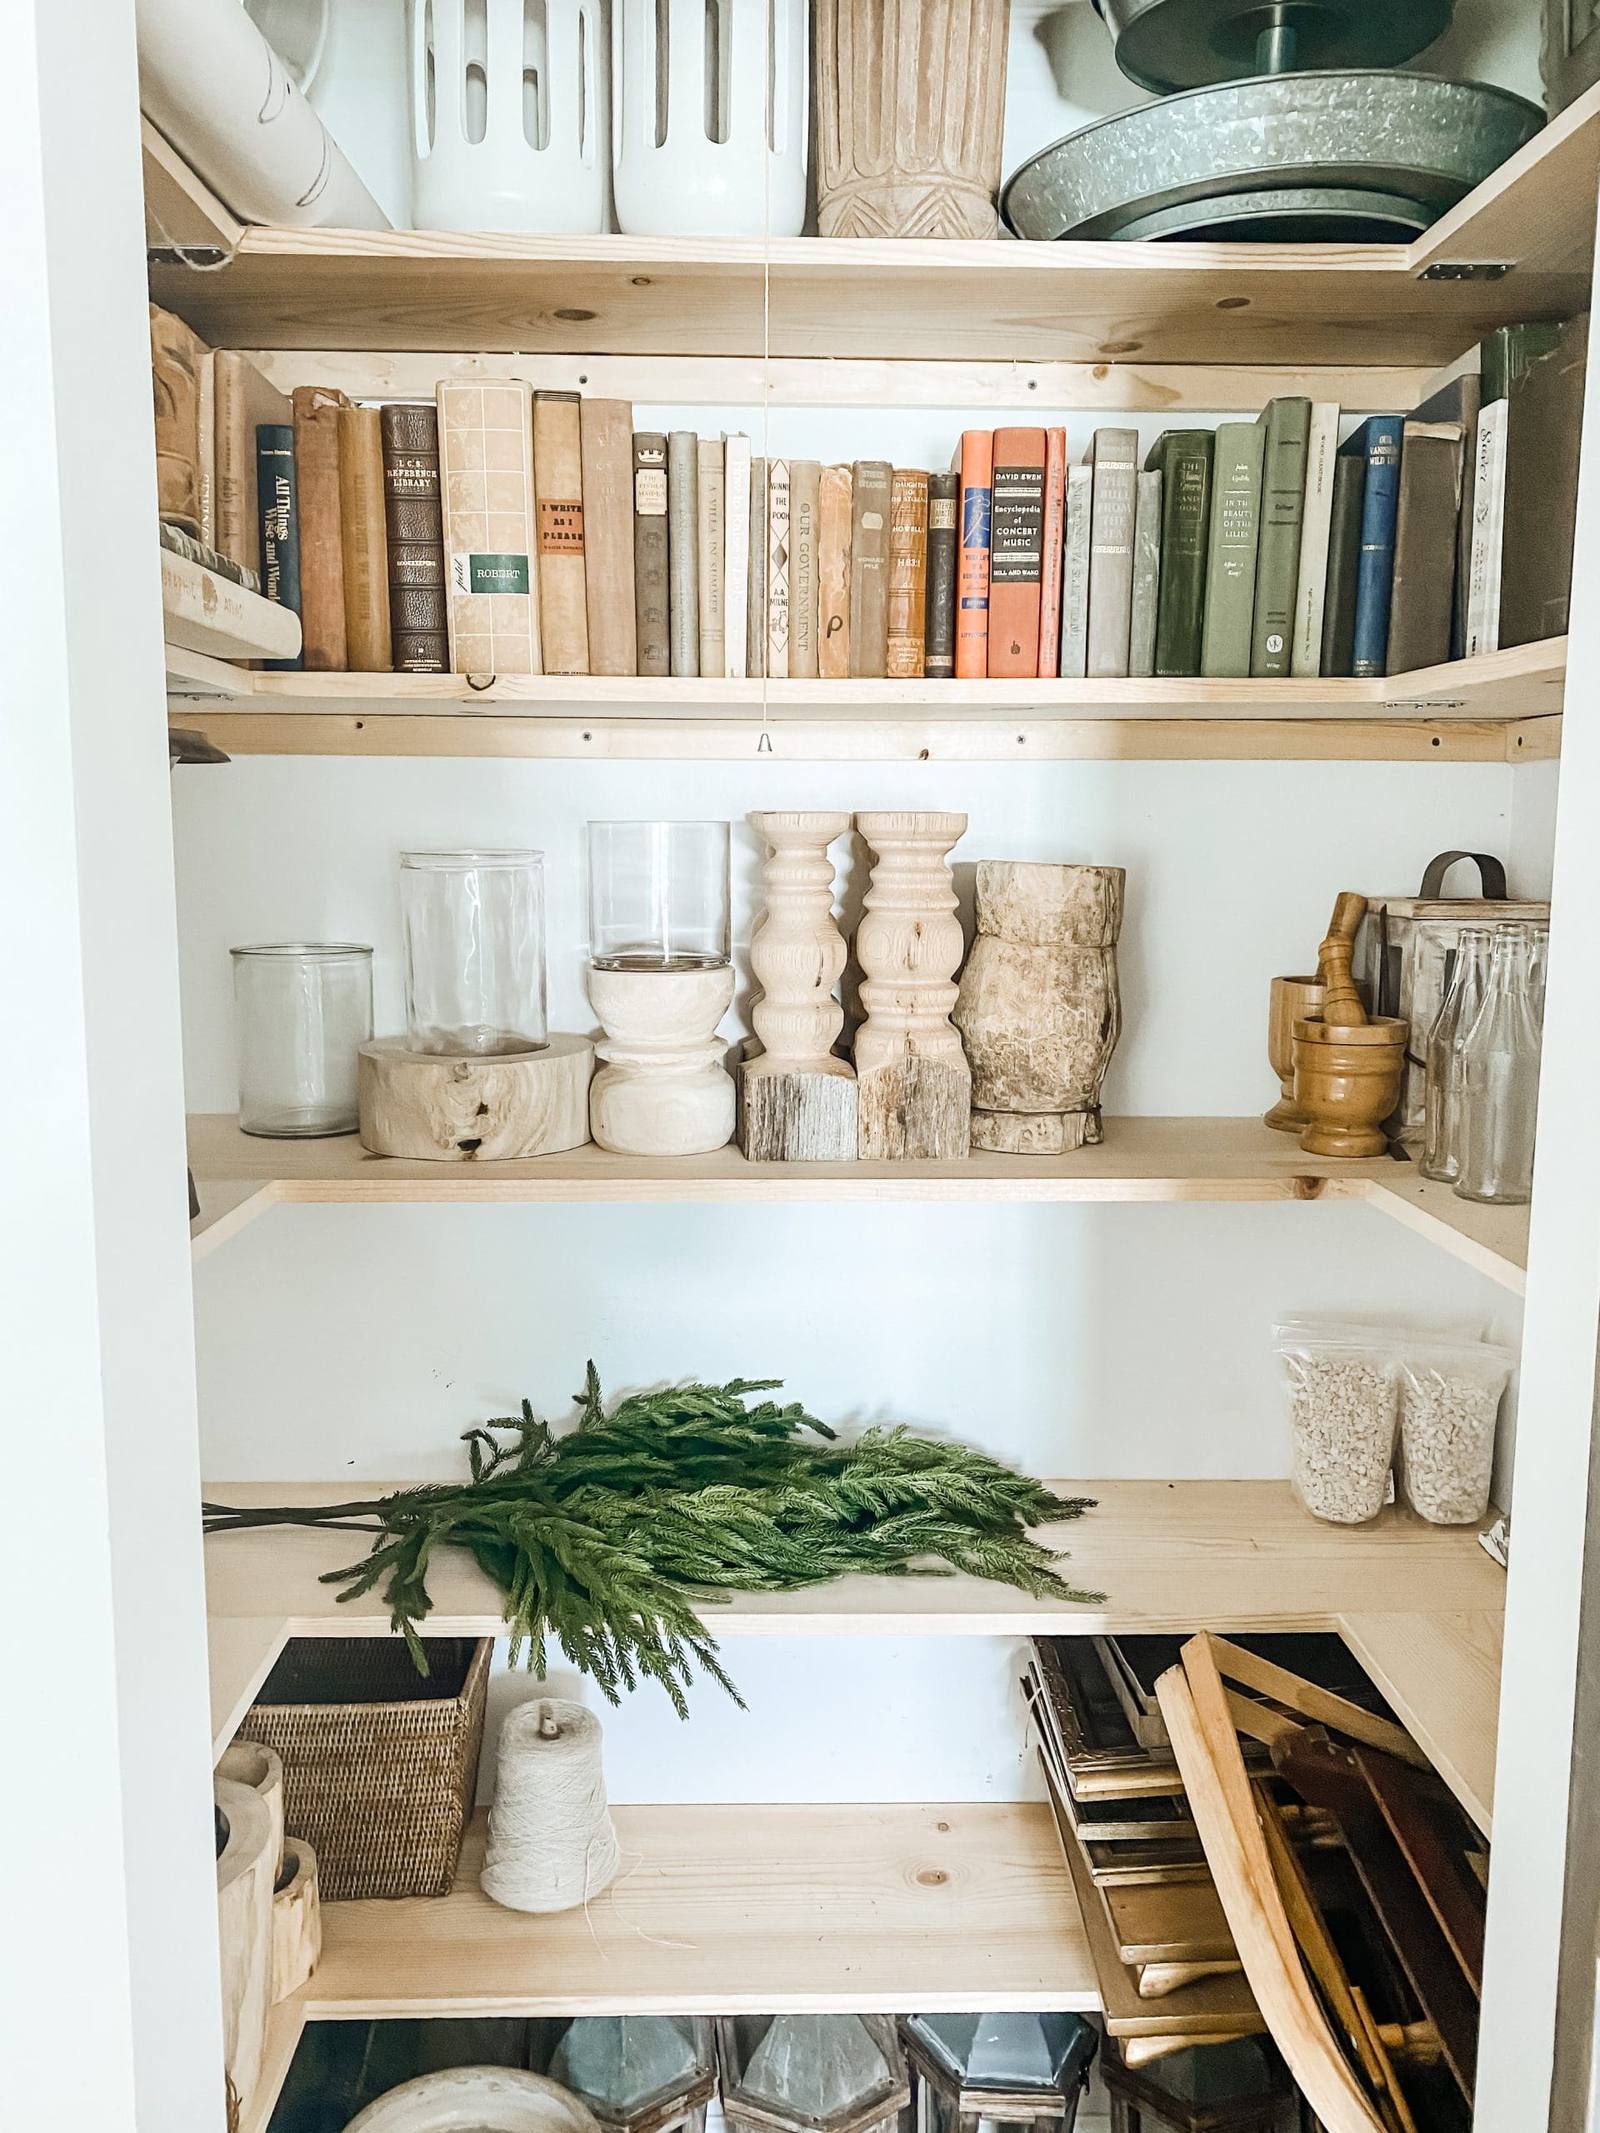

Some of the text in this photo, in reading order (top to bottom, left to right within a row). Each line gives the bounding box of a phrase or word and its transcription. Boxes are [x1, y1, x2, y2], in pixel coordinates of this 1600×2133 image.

[387, 469, 437, 478] REFERENCE
[995, 473, 1042, 481] DAVID EWEN
[275, 475, 290, 495] All
[393, 478, 431, 487] LIBRARY
[775, 497, 787, 506] THE
[550, 504, 582, 512] WRITE
[994, 505, 1041, 514] Encyclopedia
[264, 507, 278, 539] Wise
[274, 496, 291, 541] Things
[553, 518, 573, 526] AS I
[543, 532, 583, 541] PLEASE
[1003, 539, 1031, 547] MUSIC
[265, 541, 279, 565] and
[476, 569, 520, 579] ROBERT
[798, 503, 811, 651] OUR GOVERNMENT
[770, 598, 789, 606] MILNE
